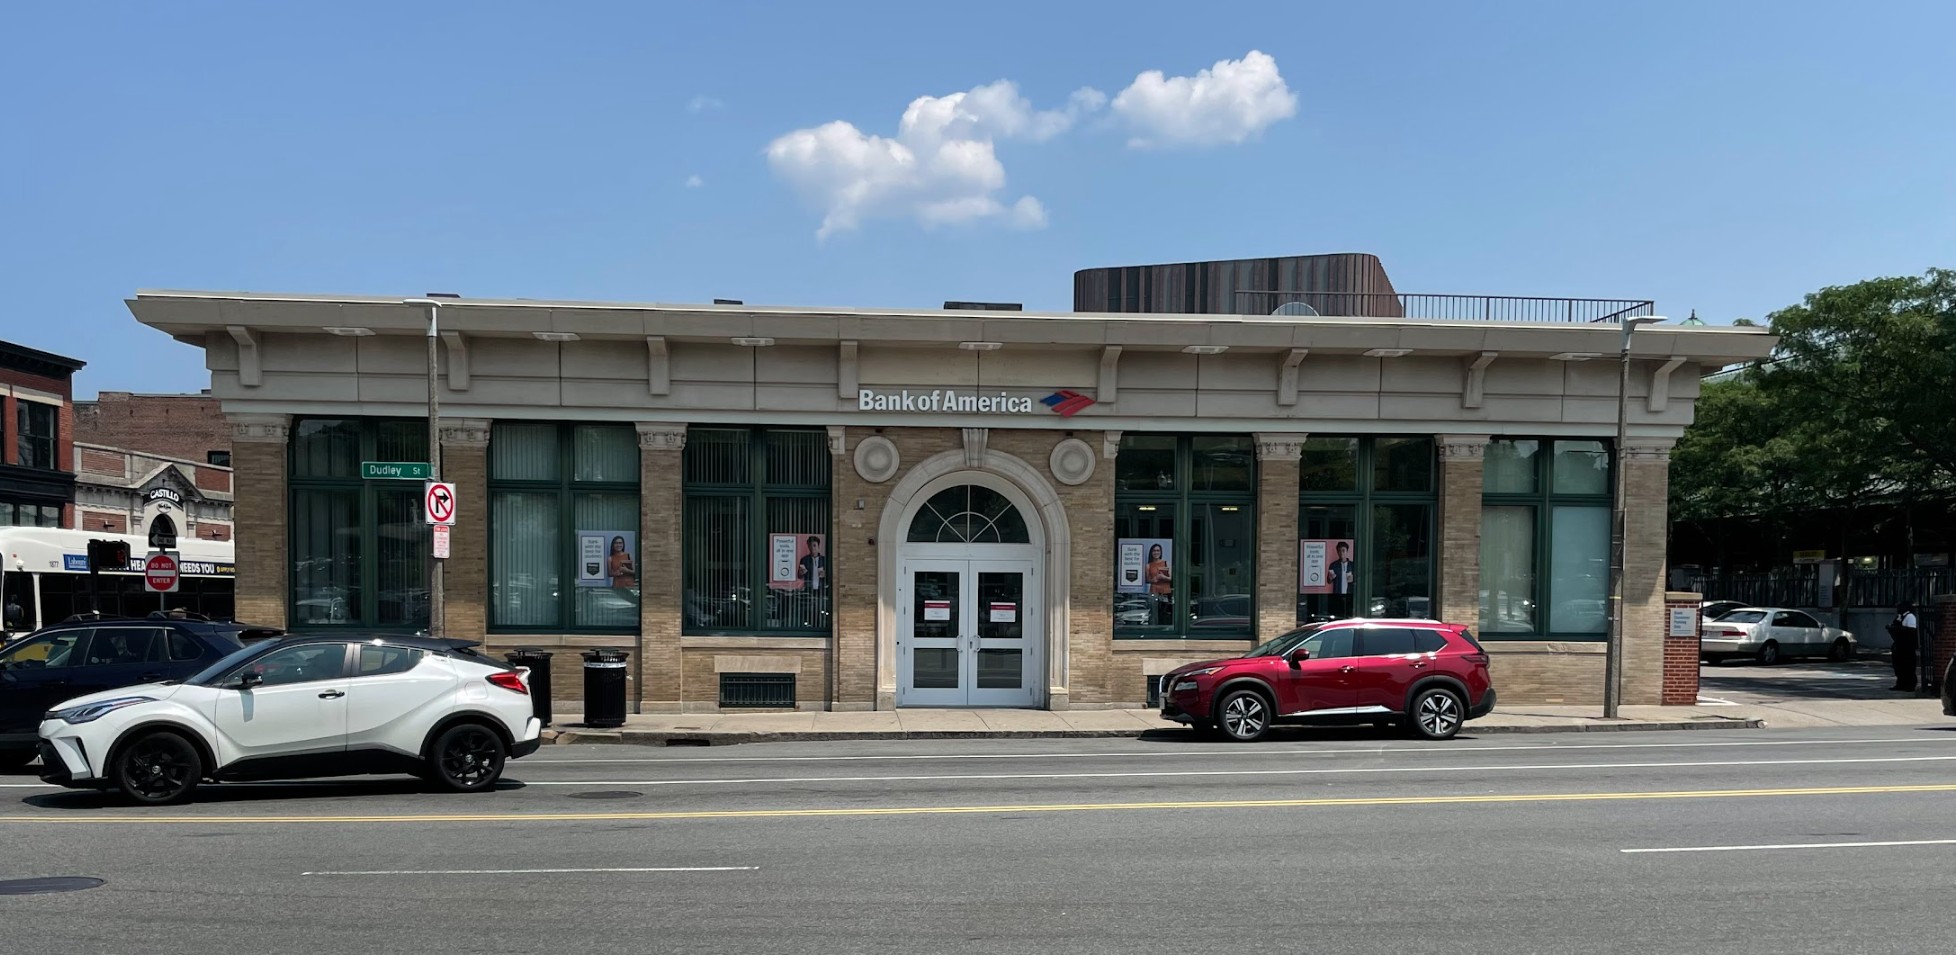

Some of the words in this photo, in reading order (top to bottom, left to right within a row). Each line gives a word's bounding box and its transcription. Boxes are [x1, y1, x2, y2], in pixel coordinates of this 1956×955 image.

[859, 389, 915, 411] Bank
[917, 389, 940, 411] of
[942, 390, 1032, 413] America
[369, 464, 402, 476] Dudley
[412, 467, 421, 475] St
[150, 488, 179, 502] CASTILLO
[180, 562, 200, 573] NEEDS
[200, 563, 215, 574] YOU
